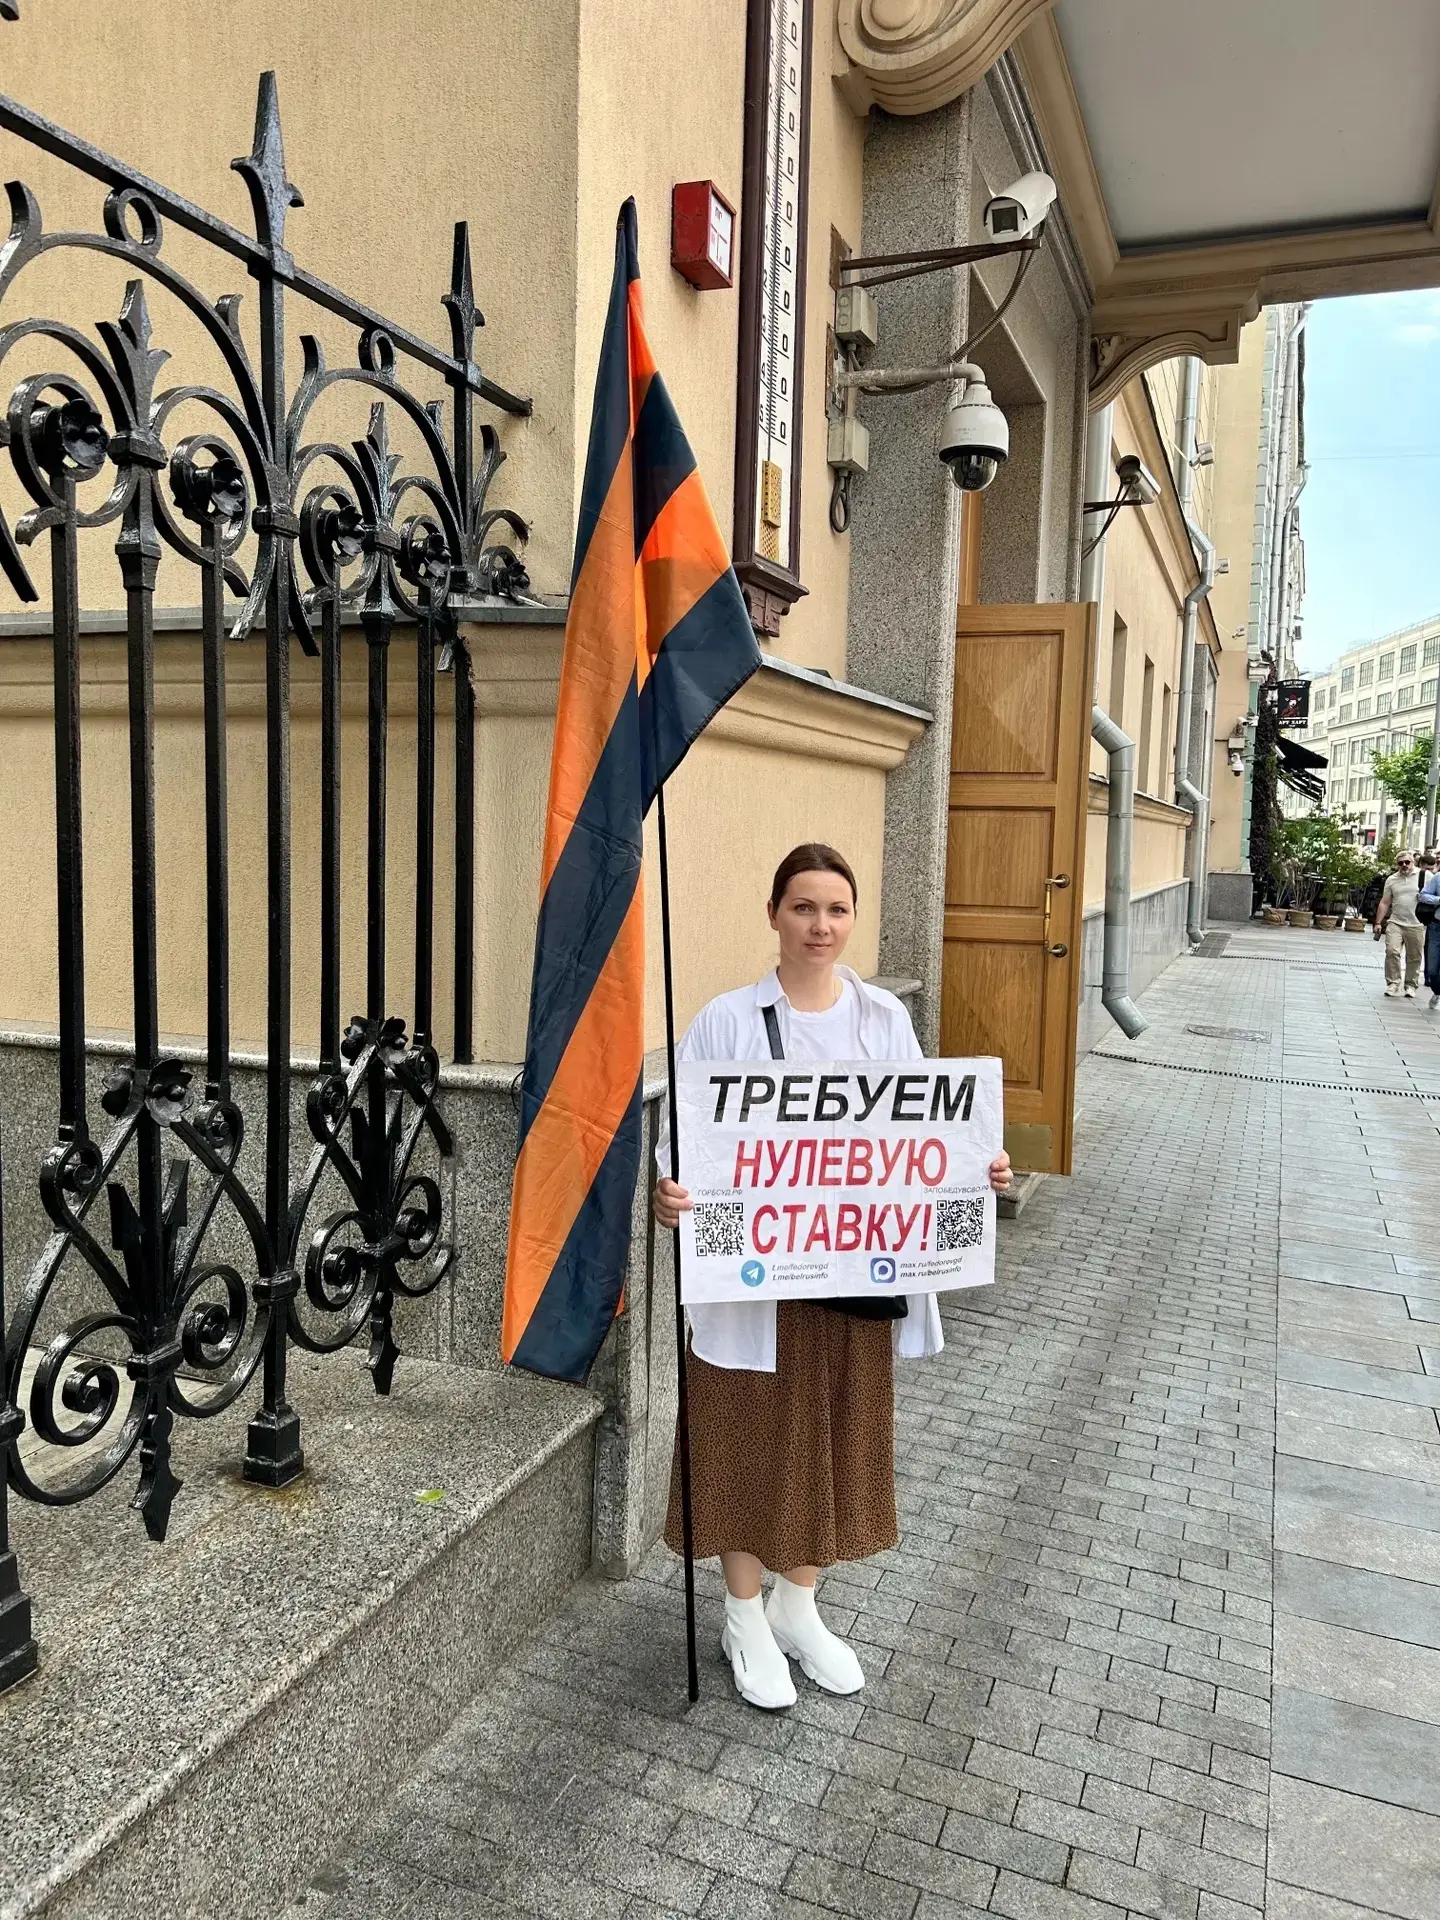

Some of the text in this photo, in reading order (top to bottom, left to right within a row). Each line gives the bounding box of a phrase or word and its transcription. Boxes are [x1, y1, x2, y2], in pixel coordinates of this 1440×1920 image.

[708, 1074, 977, 1123] ТРЕБУЕМ
[732, 1137, 949, 1189] НУЛЕВУЮ
[751, 1203, 933, 1255] СТАВКУ!
[771, 1260, 830, 1272] t.me/fedorovgd
[899, 1256, 963, 1269] max.ru/fedorovgd
[772, 1272, 829, 1282] t.me/belrusinfo
[900, 1265, 962, 1279] max.ru/belrusinfo
